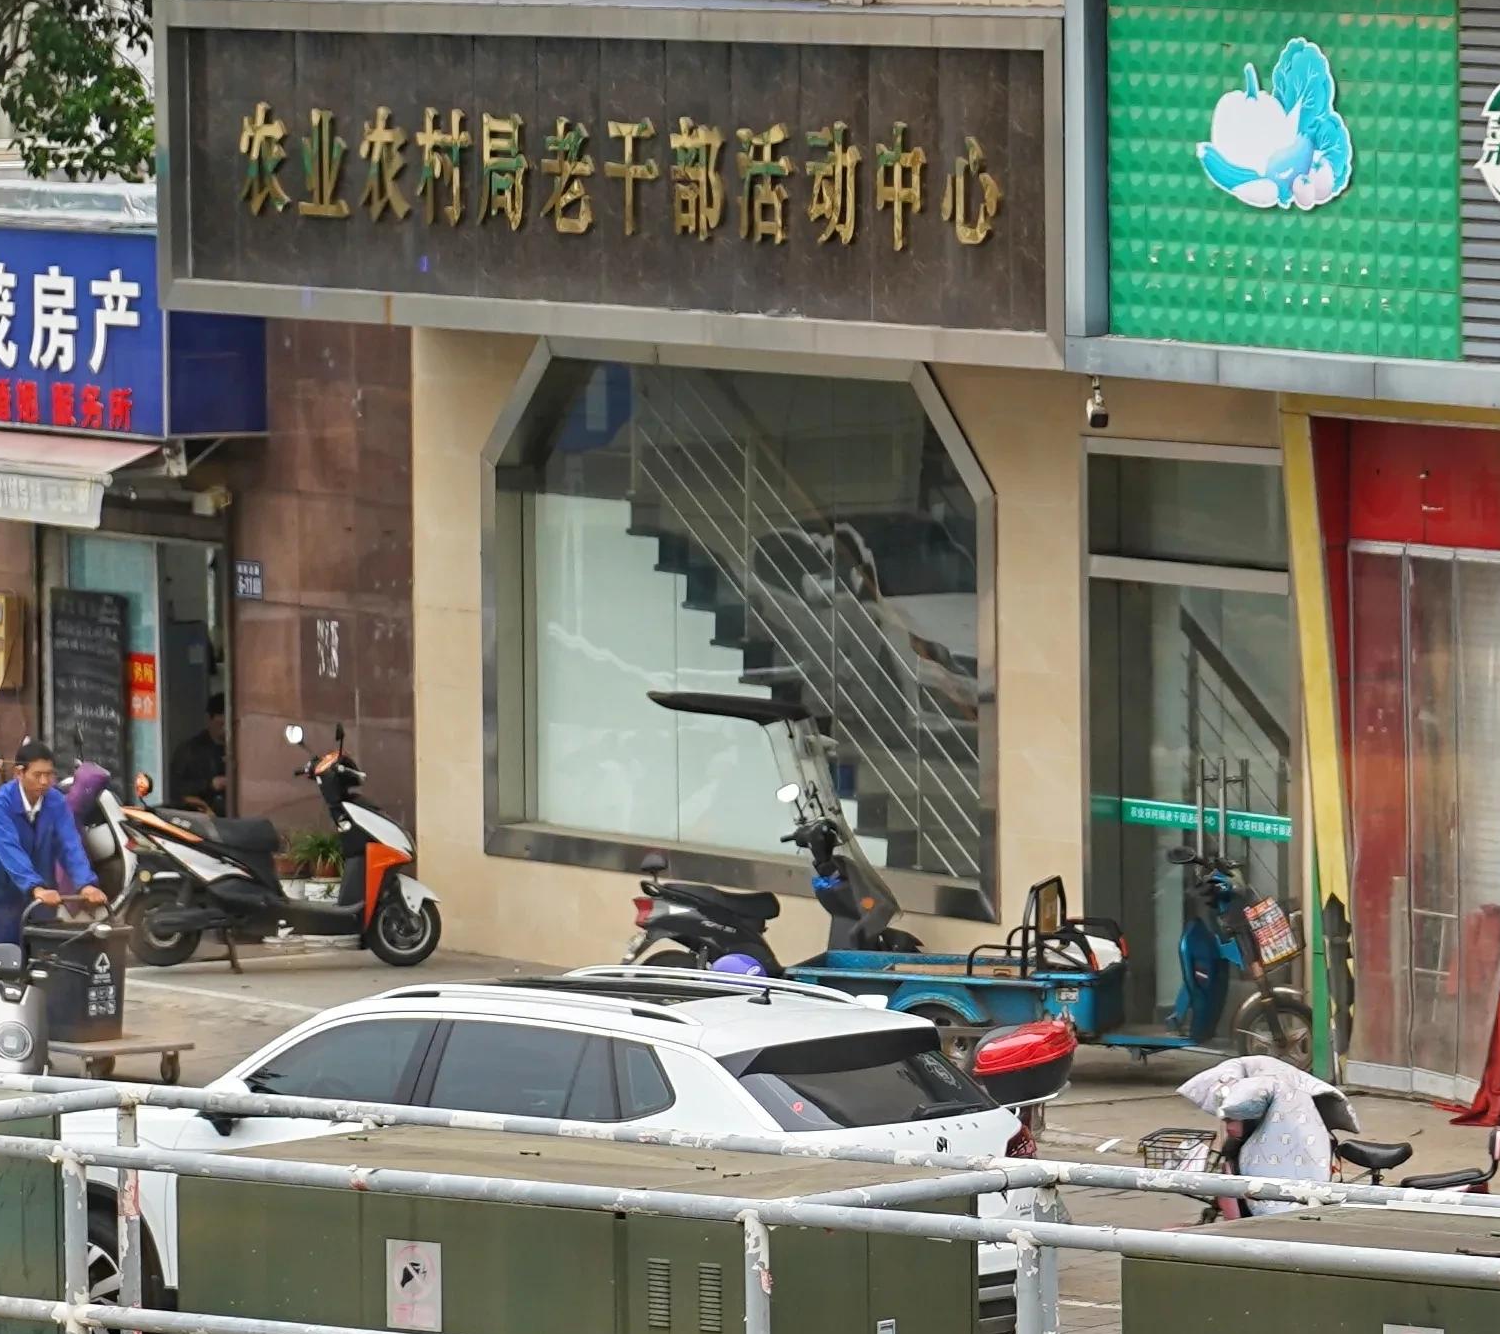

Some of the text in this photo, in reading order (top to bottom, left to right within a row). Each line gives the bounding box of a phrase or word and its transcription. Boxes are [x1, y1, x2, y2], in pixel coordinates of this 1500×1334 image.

[241, 101, 1002, 249] 农业农村局老干部活动中心
[51, 381, 133, 431] 服务所
